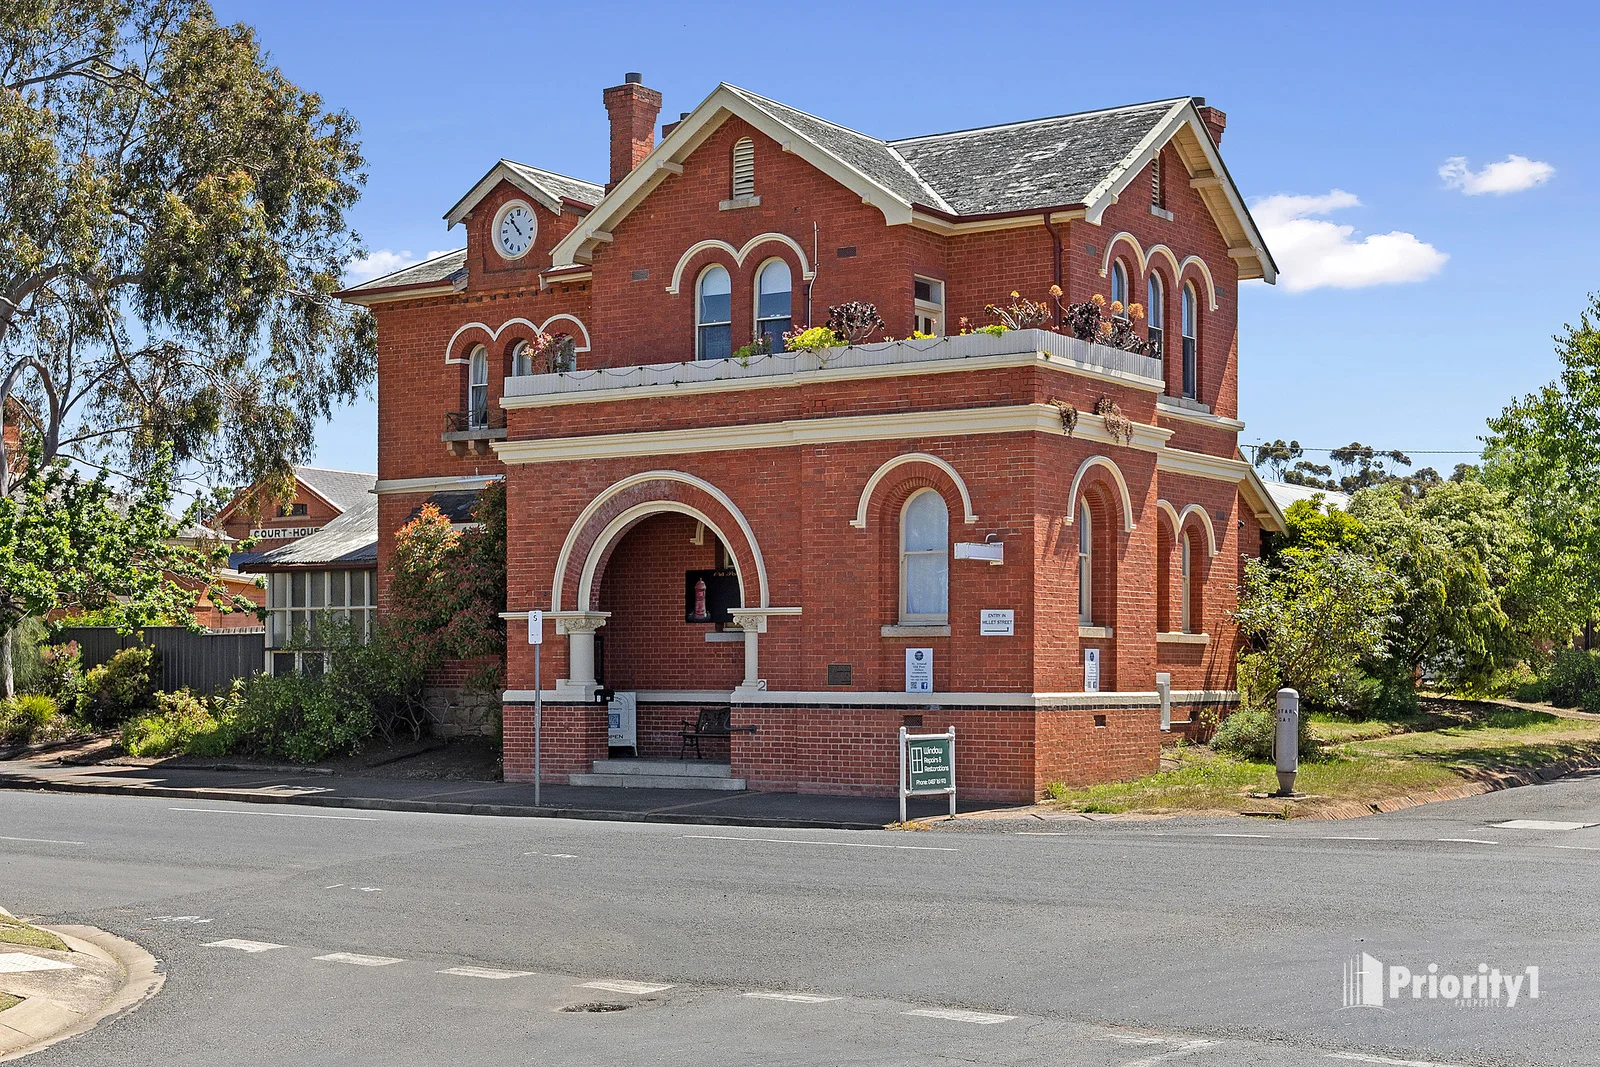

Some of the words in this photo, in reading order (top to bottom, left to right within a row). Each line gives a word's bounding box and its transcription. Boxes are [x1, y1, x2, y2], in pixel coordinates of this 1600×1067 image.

[254, 528, 323, 538] COURT-HOUS
[758, 680, 766, 692] 2
[923, 746, 942, 754] Window
[924, 756, 938, 764] Repairs
